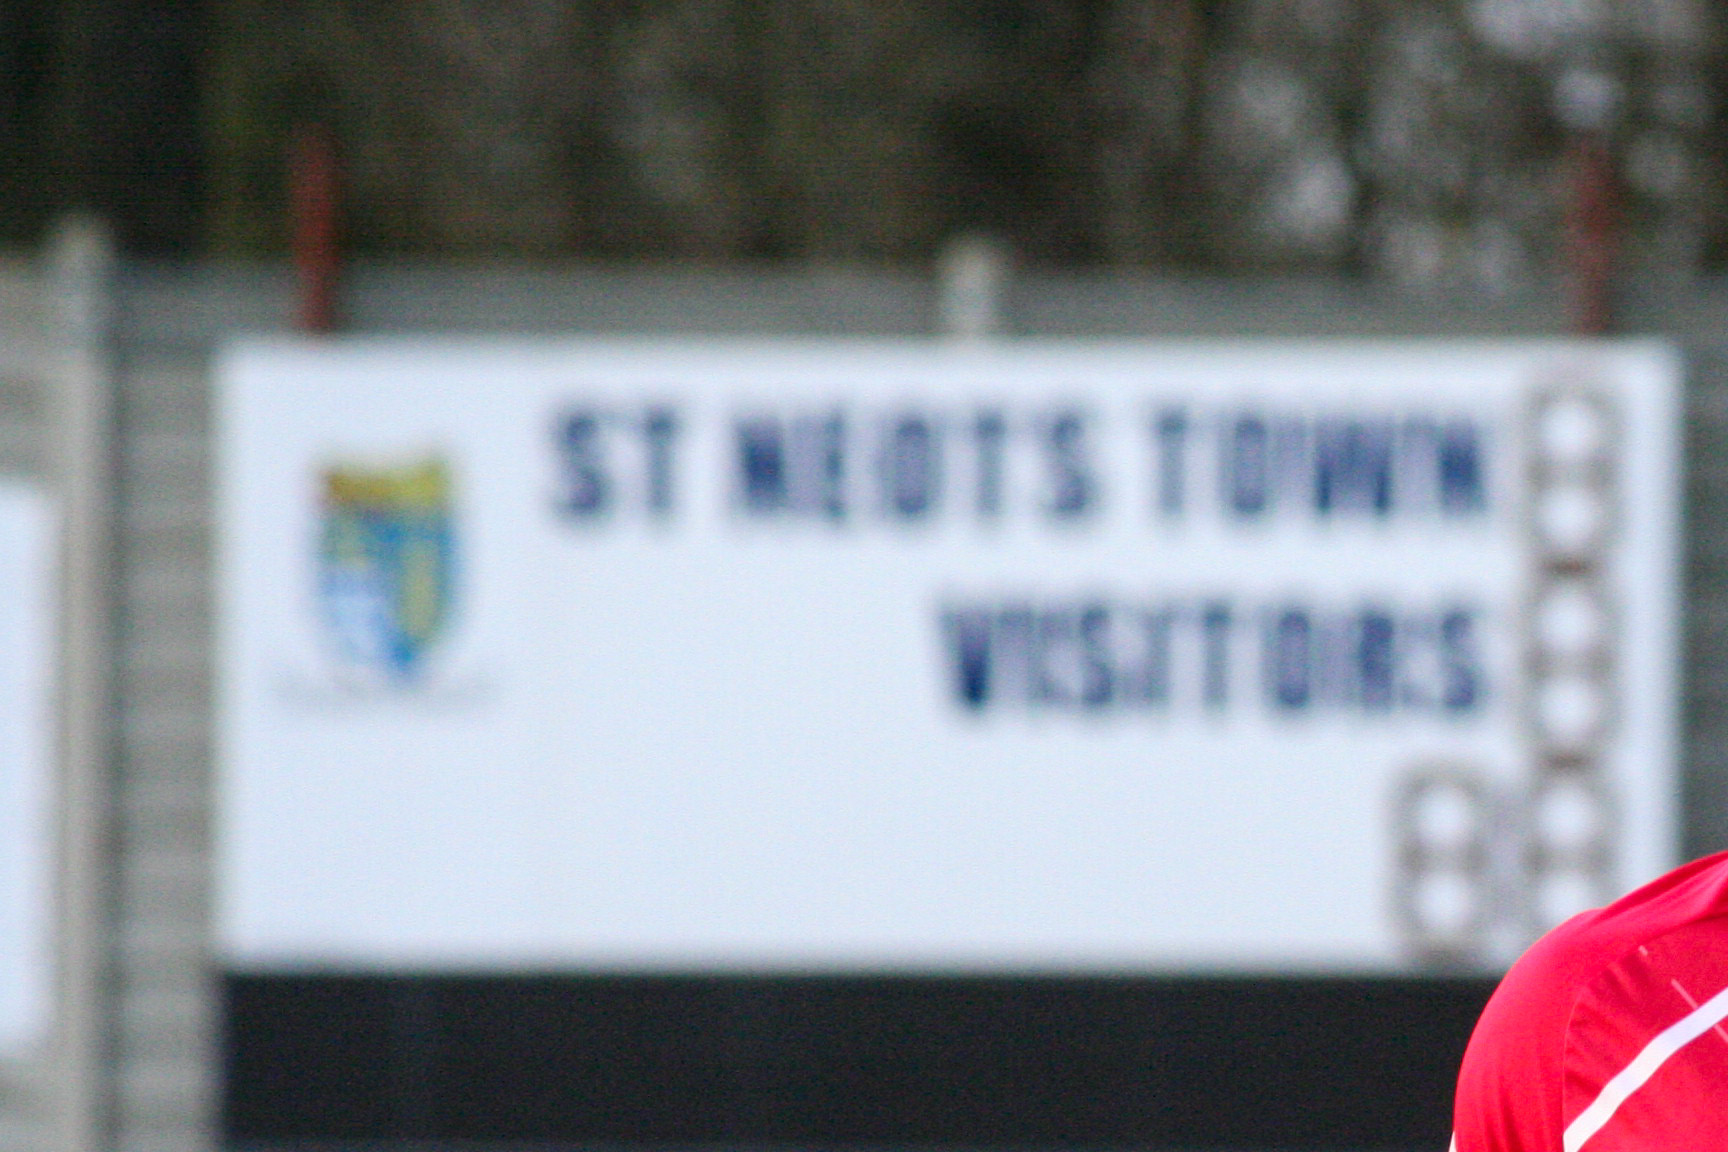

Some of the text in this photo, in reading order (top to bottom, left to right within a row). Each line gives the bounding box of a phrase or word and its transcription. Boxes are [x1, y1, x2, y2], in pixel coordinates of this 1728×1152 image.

[552, 404, 1490, 524] ST NEOTS TOWN
[938, 602, 1486, 716] VISITORS
